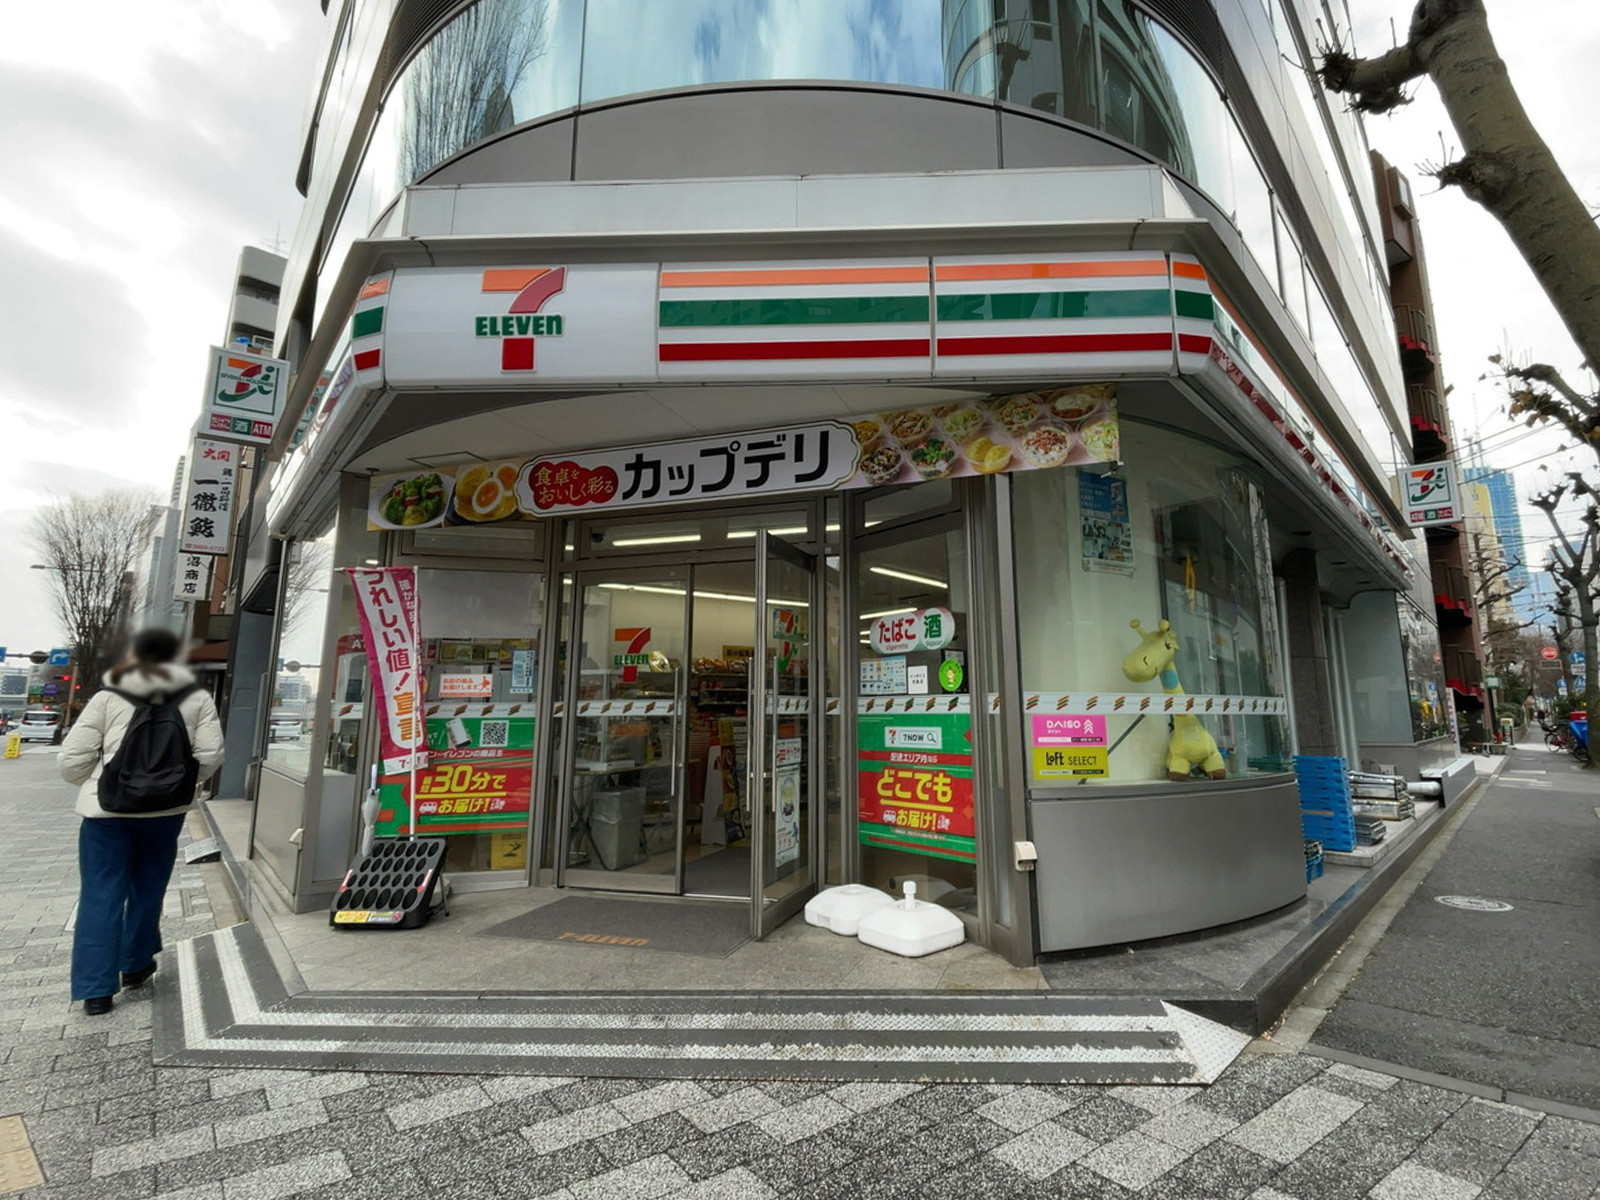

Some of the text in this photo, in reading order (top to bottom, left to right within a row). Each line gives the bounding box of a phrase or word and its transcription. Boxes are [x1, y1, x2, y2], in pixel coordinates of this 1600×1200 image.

[253, 423, 272, 436] ATM
[622, 430, 830, 500] カップデリ
[535, 466, 580, 487] 食卓を
[539, 476, 614, 504] おいしく彩る
[879, 613, 942, 643] たばこ 酒
[1046, 720, 1081, 729] DAISO
[903, 733, 924, 742] 7NOW
[1068, 755, 1097, 766] SELECT
[877, 769, 952, 803] どこでも
